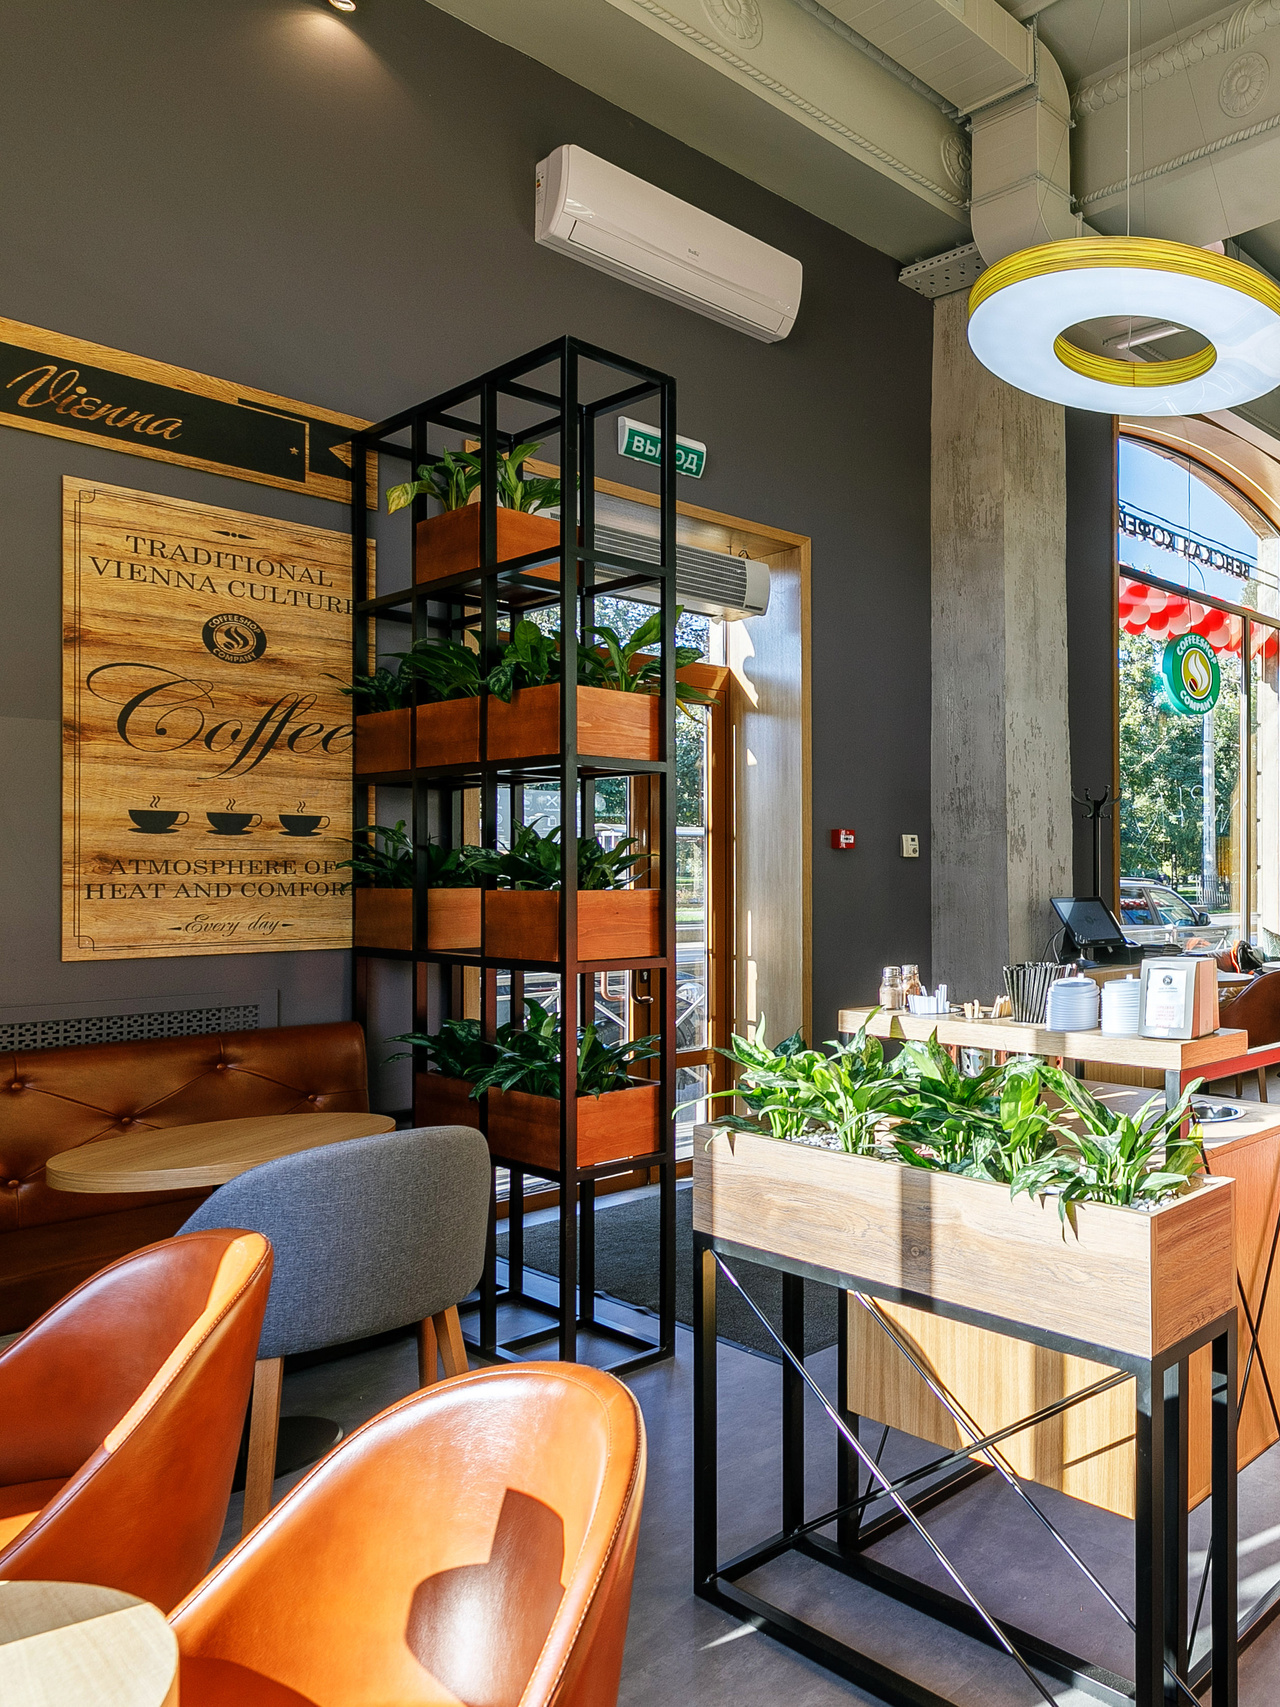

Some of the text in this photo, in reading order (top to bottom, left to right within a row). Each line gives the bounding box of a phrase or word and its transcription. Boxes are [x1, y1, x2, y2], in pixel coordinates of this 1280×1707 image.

[6, 365, 183, 440] Vienna
[632, 435, 698, 473] ВЫОД
[125, 534, 334, 588] TRADITIONAL
[89, 556, 218, 595] VIENNA
[208, 615, 262, 634] COFFEESHOP
[213, 648, 257, 663] COMPANY
[1176, 635, 1217, 664] COFFEESHOP
[1180, 690, 1215, 712] COMPANY
[86, 662, 355, 780] Coffee
[108, 858, 339, 876] ATMOSPHERE OF
[84, 881, 348, 900] HEAT AND COMFOR
[184, 911, 281, 937] Every day
